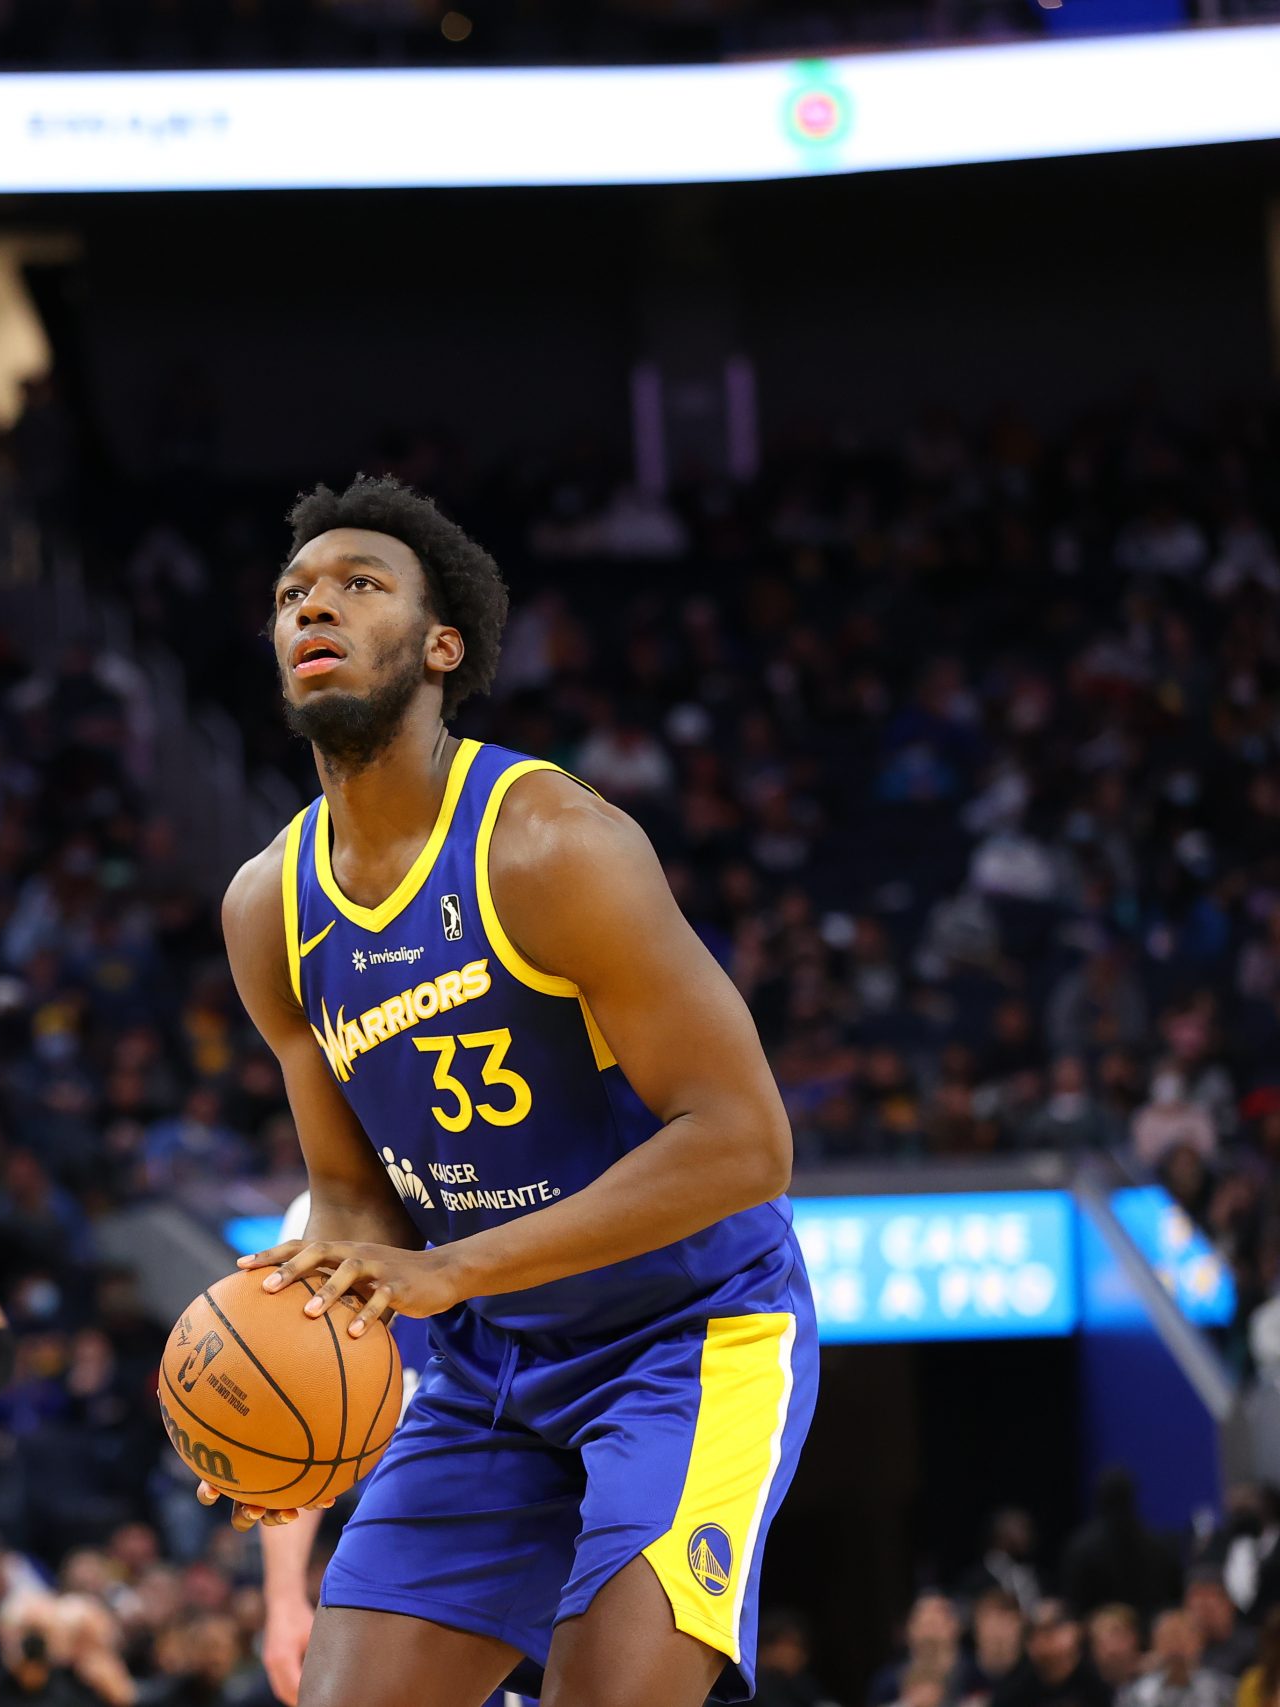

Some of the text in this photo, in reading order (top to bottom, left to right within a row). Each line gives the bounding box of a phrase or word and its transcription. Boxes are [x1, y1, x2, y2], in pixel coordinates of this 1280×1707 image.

[310, 959, 492, 1082] WARRIORS
[412, 1027, 532, 1133] 33
[428, 1163, 479, 1184] KAISER
